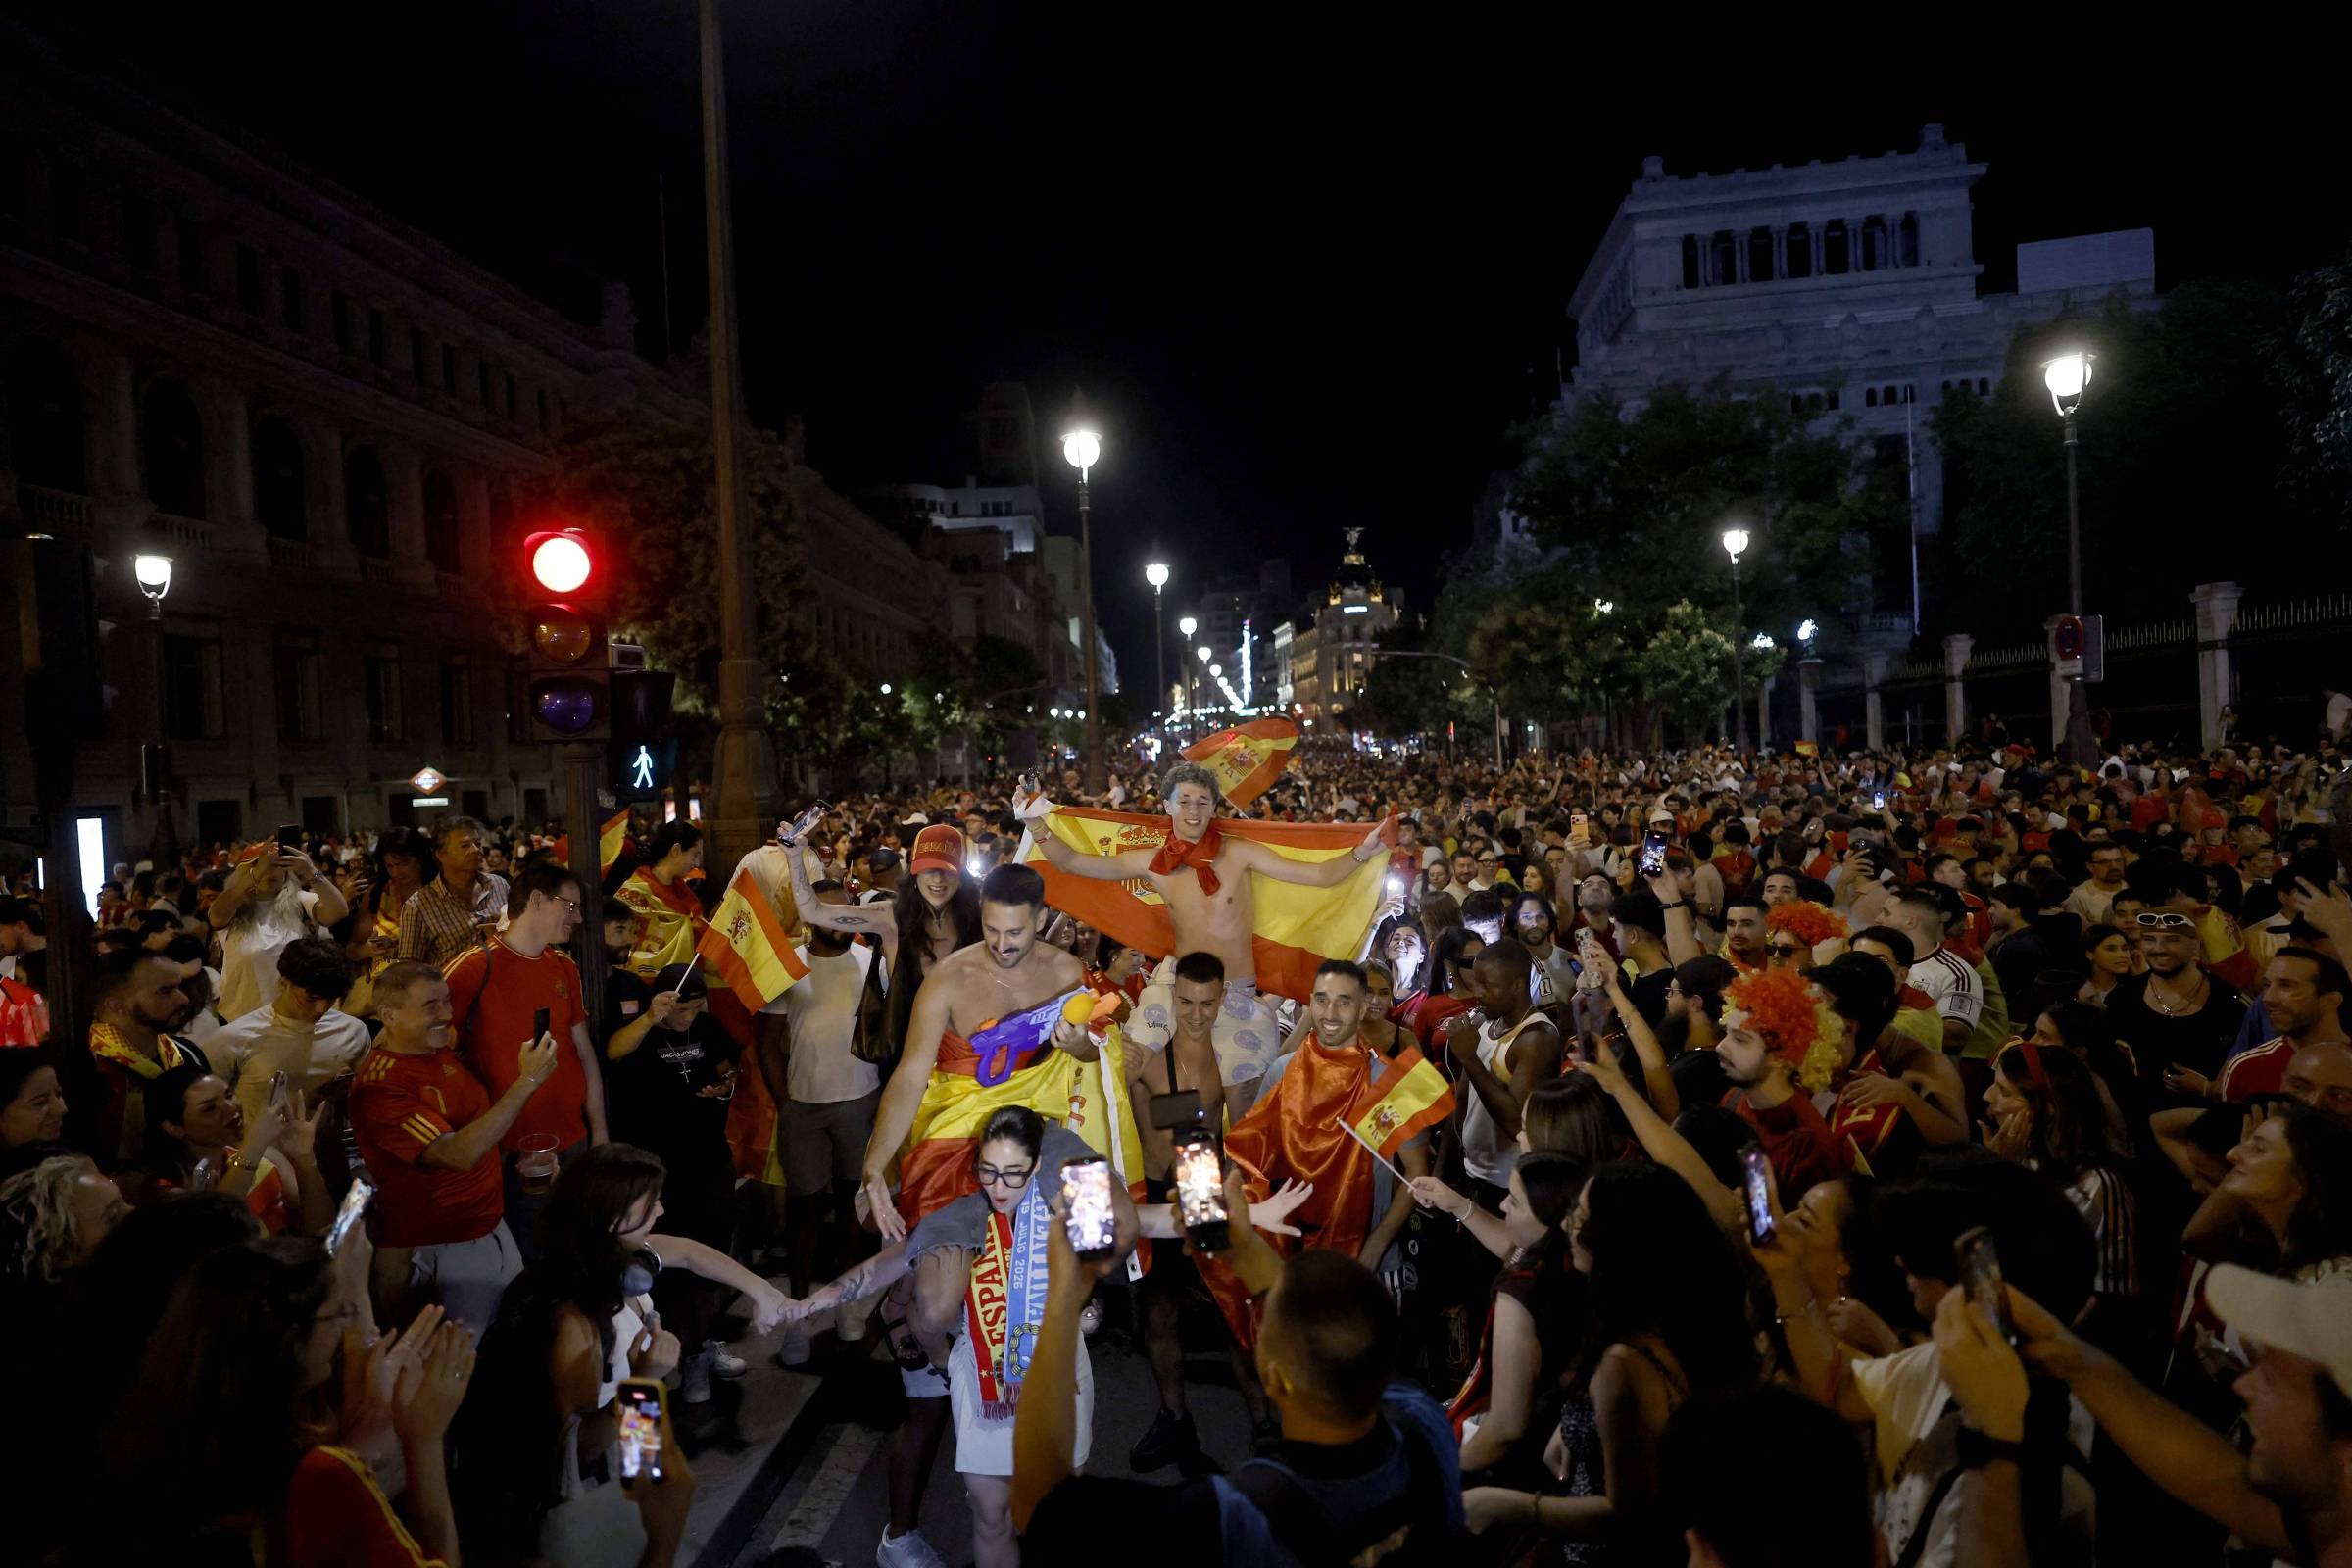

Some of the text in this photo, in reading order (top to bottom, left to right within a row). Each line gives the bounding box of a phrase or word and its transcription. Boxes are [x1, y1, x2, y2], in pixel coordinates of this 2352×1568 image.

[972, 1221, 1007, 1347] ESPA
[1013, 1201, 1031, 1290] 19 JULIO 2026
[1028, 1179, 1049, 1321] GENTINA
